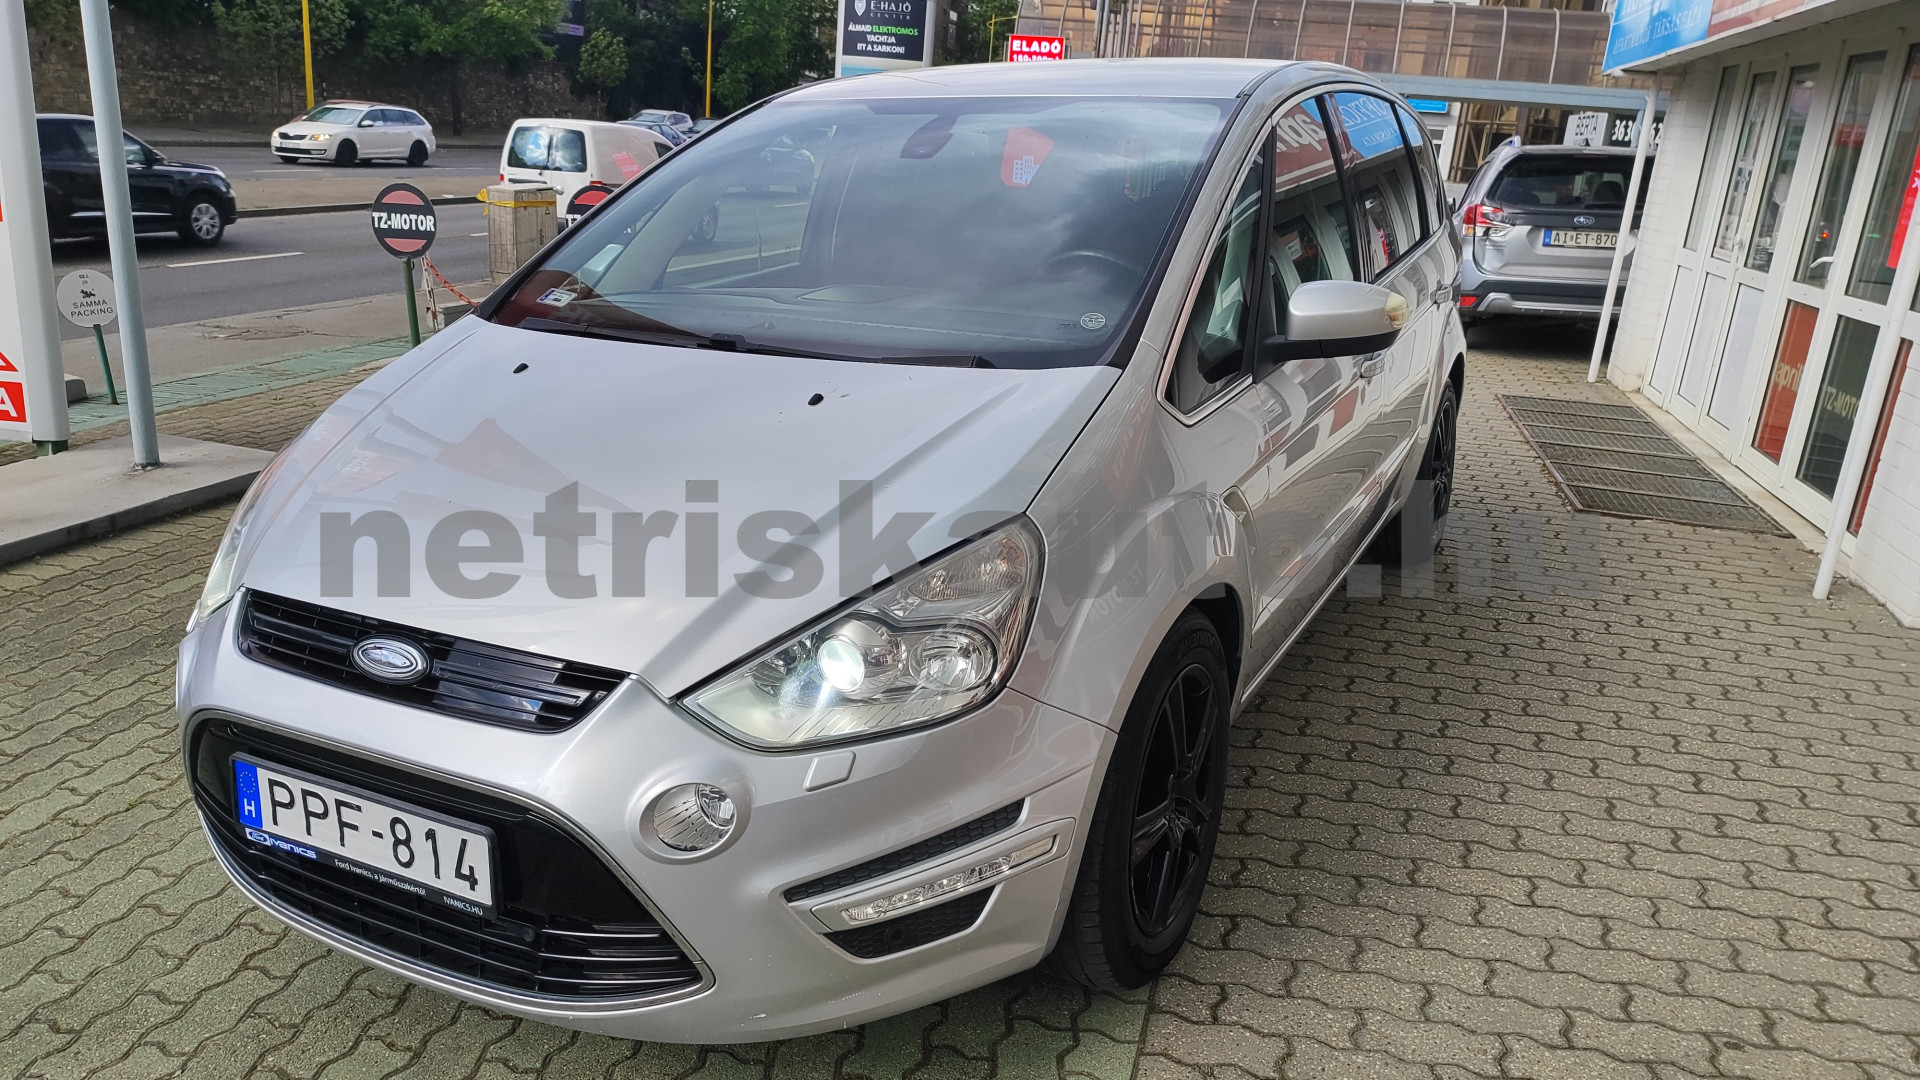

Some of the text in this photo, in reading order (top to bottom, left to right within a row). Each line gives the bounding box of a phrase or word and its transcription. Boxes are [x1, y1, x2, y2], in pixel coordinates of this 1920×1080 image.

[848, 22, 919, 36] ÁLMAID ELEKTROMOS
[866, 34, 896, 43] YACHTJA
[1012, 39, 1062, 54] ELADÓ
[1575, 114, 1598, 136] BERTA
[371, 211, 435, 232] TZ-MOTOR
[1553, 232, 1568, 244] AI
[72, 299, 108, 309] SAMMA
[70, 306, 114, 318] PACKING
[243, 777, 478, 892] H PPF-814
[334, 858, 350, 870] Ford
[443, 895, 483, 916] IVANICS.HU
